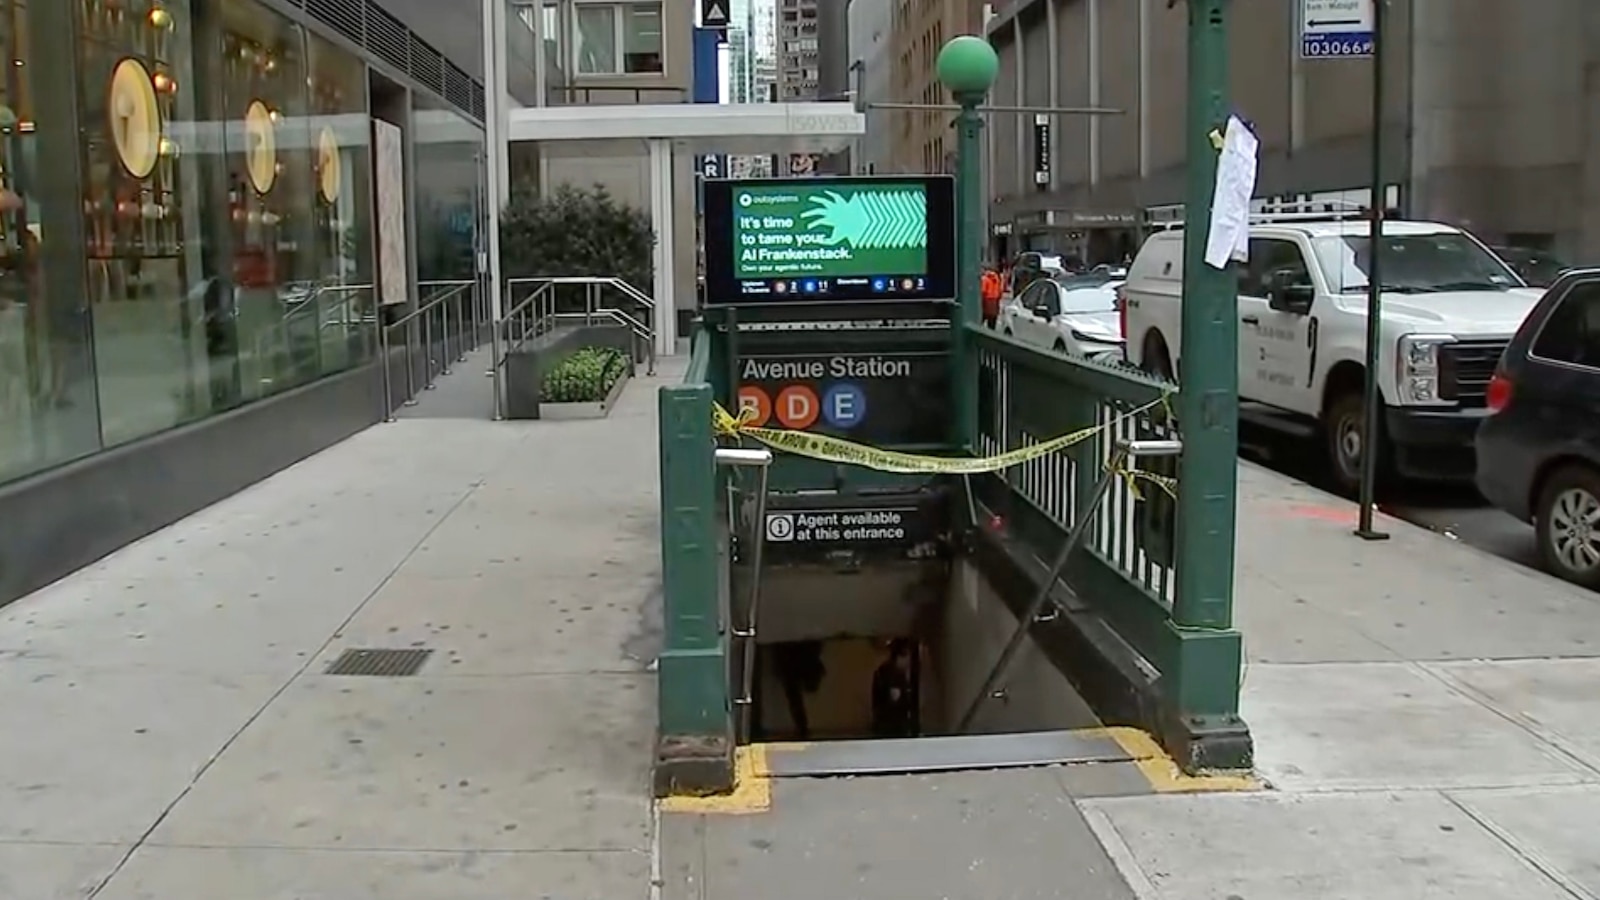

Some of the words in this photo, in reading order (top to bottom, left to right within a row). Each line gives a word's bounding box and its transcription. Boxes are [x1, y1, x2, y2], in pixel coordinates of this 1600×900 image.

[740, 216, 761, 229] It's
[763, 215, 794, 229] time
[741, 233, 756, 246] to
[758, 233, 793, 246] tame
[795, 233, 827, 248] your
[741, 248, 758, 261] AI
[759, 247, 854, 261] Frankenstack.
[742, 359, 824, 379] Avenue
[829, 356, 910, 378] Station
[788, 394, 810, 420] D
[835, 393, 854, 419] E
[797, 513, 838, 528] Agent
[841, 511, 901, 526] available
[797, 528, 811, 541] at
[815, 527, 841, 541] this
[843, 526, 904, 540] entrance
